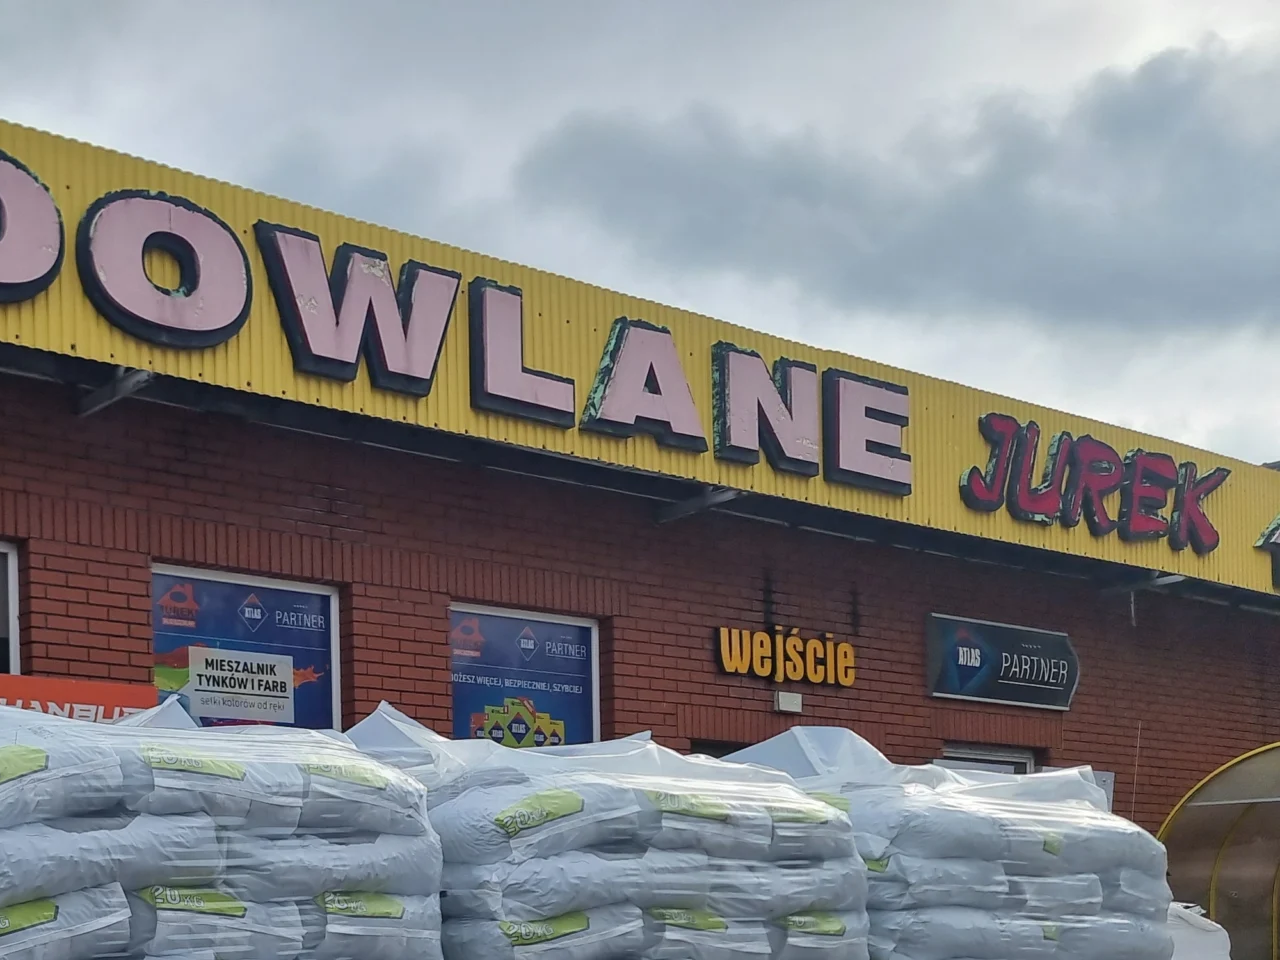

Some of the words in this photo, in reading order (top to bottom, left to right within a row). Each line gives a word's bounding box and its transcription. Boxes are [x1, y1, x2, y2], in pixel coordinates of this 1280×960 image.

[960, 412, 1231, 556] JUREK
[275, 610, 326, 629] PARTNER
[545, 641, 587, 658] PARTNER
[718, 625, 856, 687] wejście
[957, 646, 981, 669] ATLAS
[205, 658, 277, 677] MIESZALNIK
[1000, 652, 1069, 685] PARTNER
[196, 673, 247, 690] TYNKÓW
[258, 680, 287, 693] FARB
[201, 696, 221, 706] setki
[222, 697, 256, 709] kolorów
[257, 700, 267, 710] od
[269, 701, 285, 713] ręki
